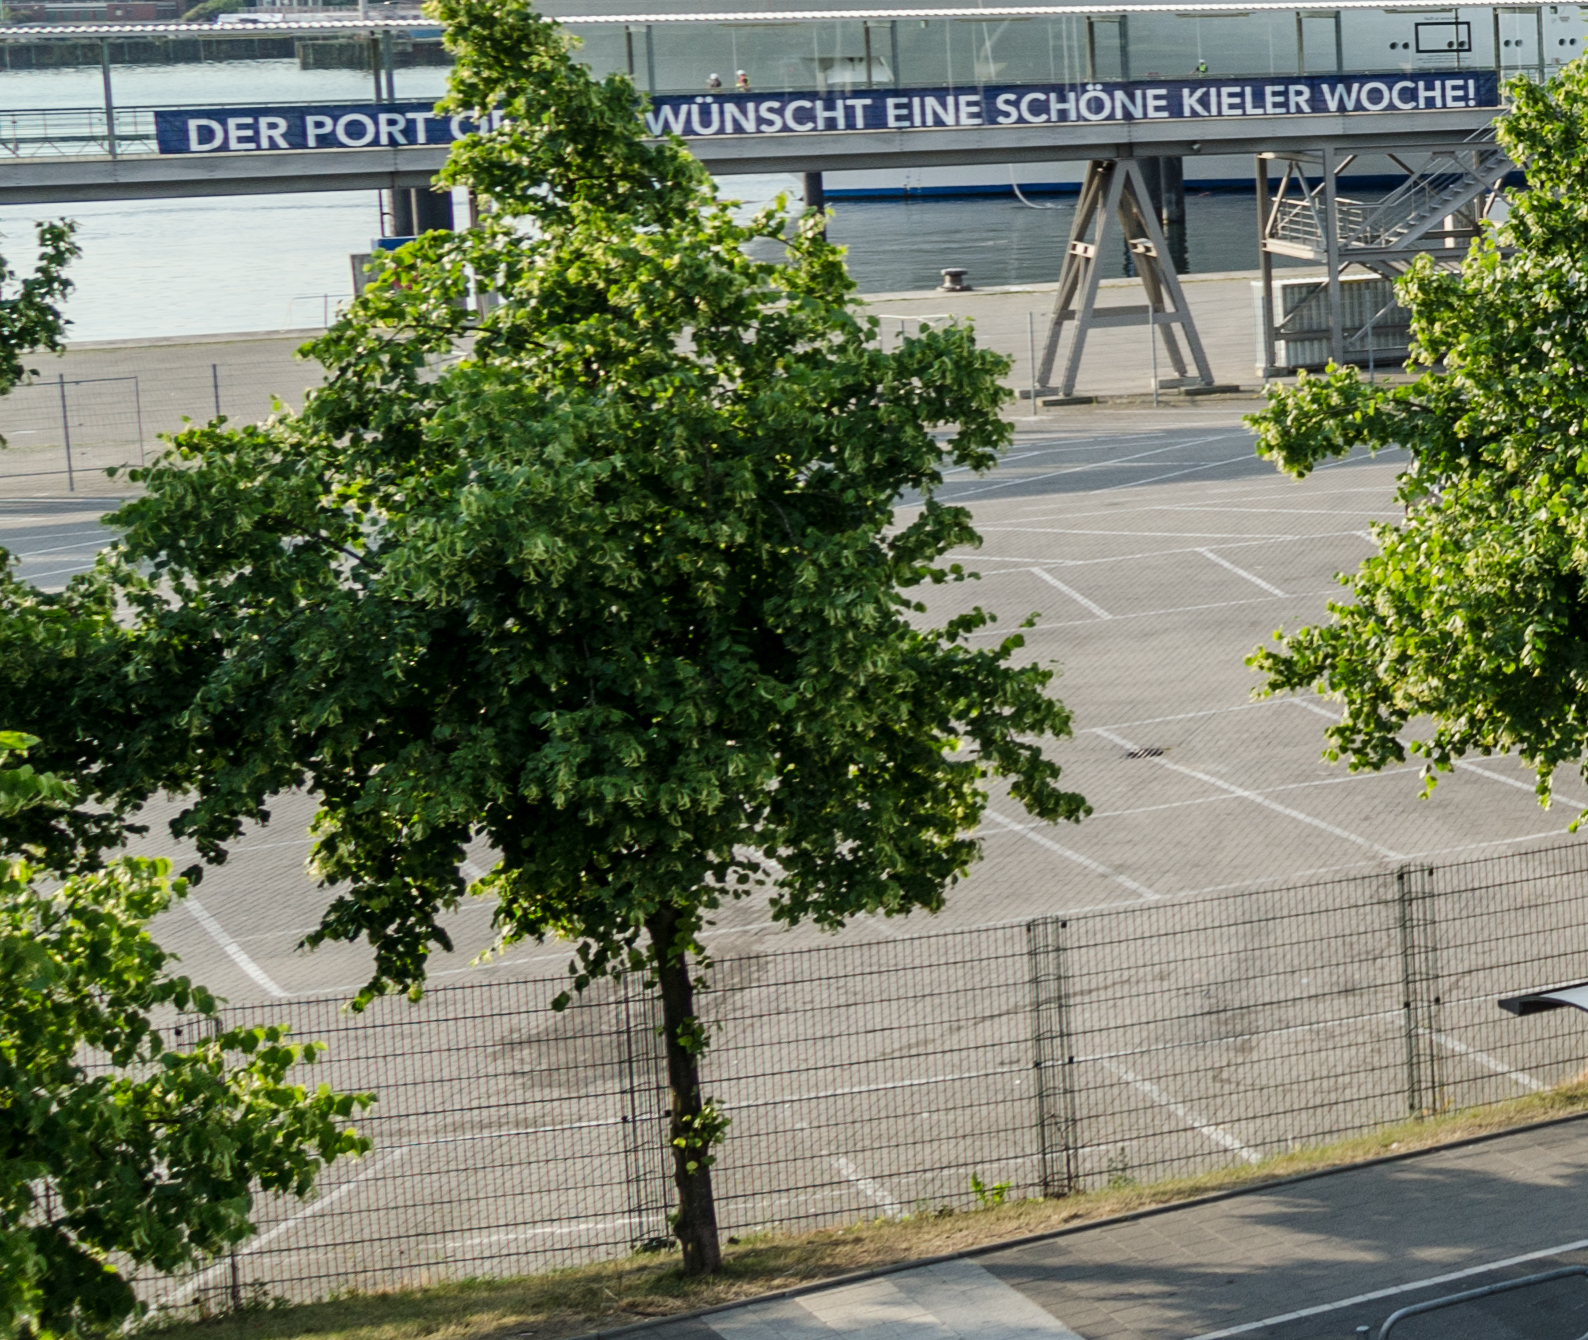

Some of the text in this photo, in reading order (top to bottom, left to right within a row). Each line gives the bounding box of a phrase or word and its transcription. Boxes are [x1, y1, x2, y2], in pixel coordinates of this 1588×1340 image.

[187, 116, 290, 152] DER
[305, 112, 437, 148] PORT
[644, 95, 873, 137] WÜNSCHT
[886, 94, 983, 129] EINE
[996, 84, 1169, 124] SCHÖNE
[1182, 84, 1311, 118] KIELER
[1320, 78, 1477, 113] WOCHE!
